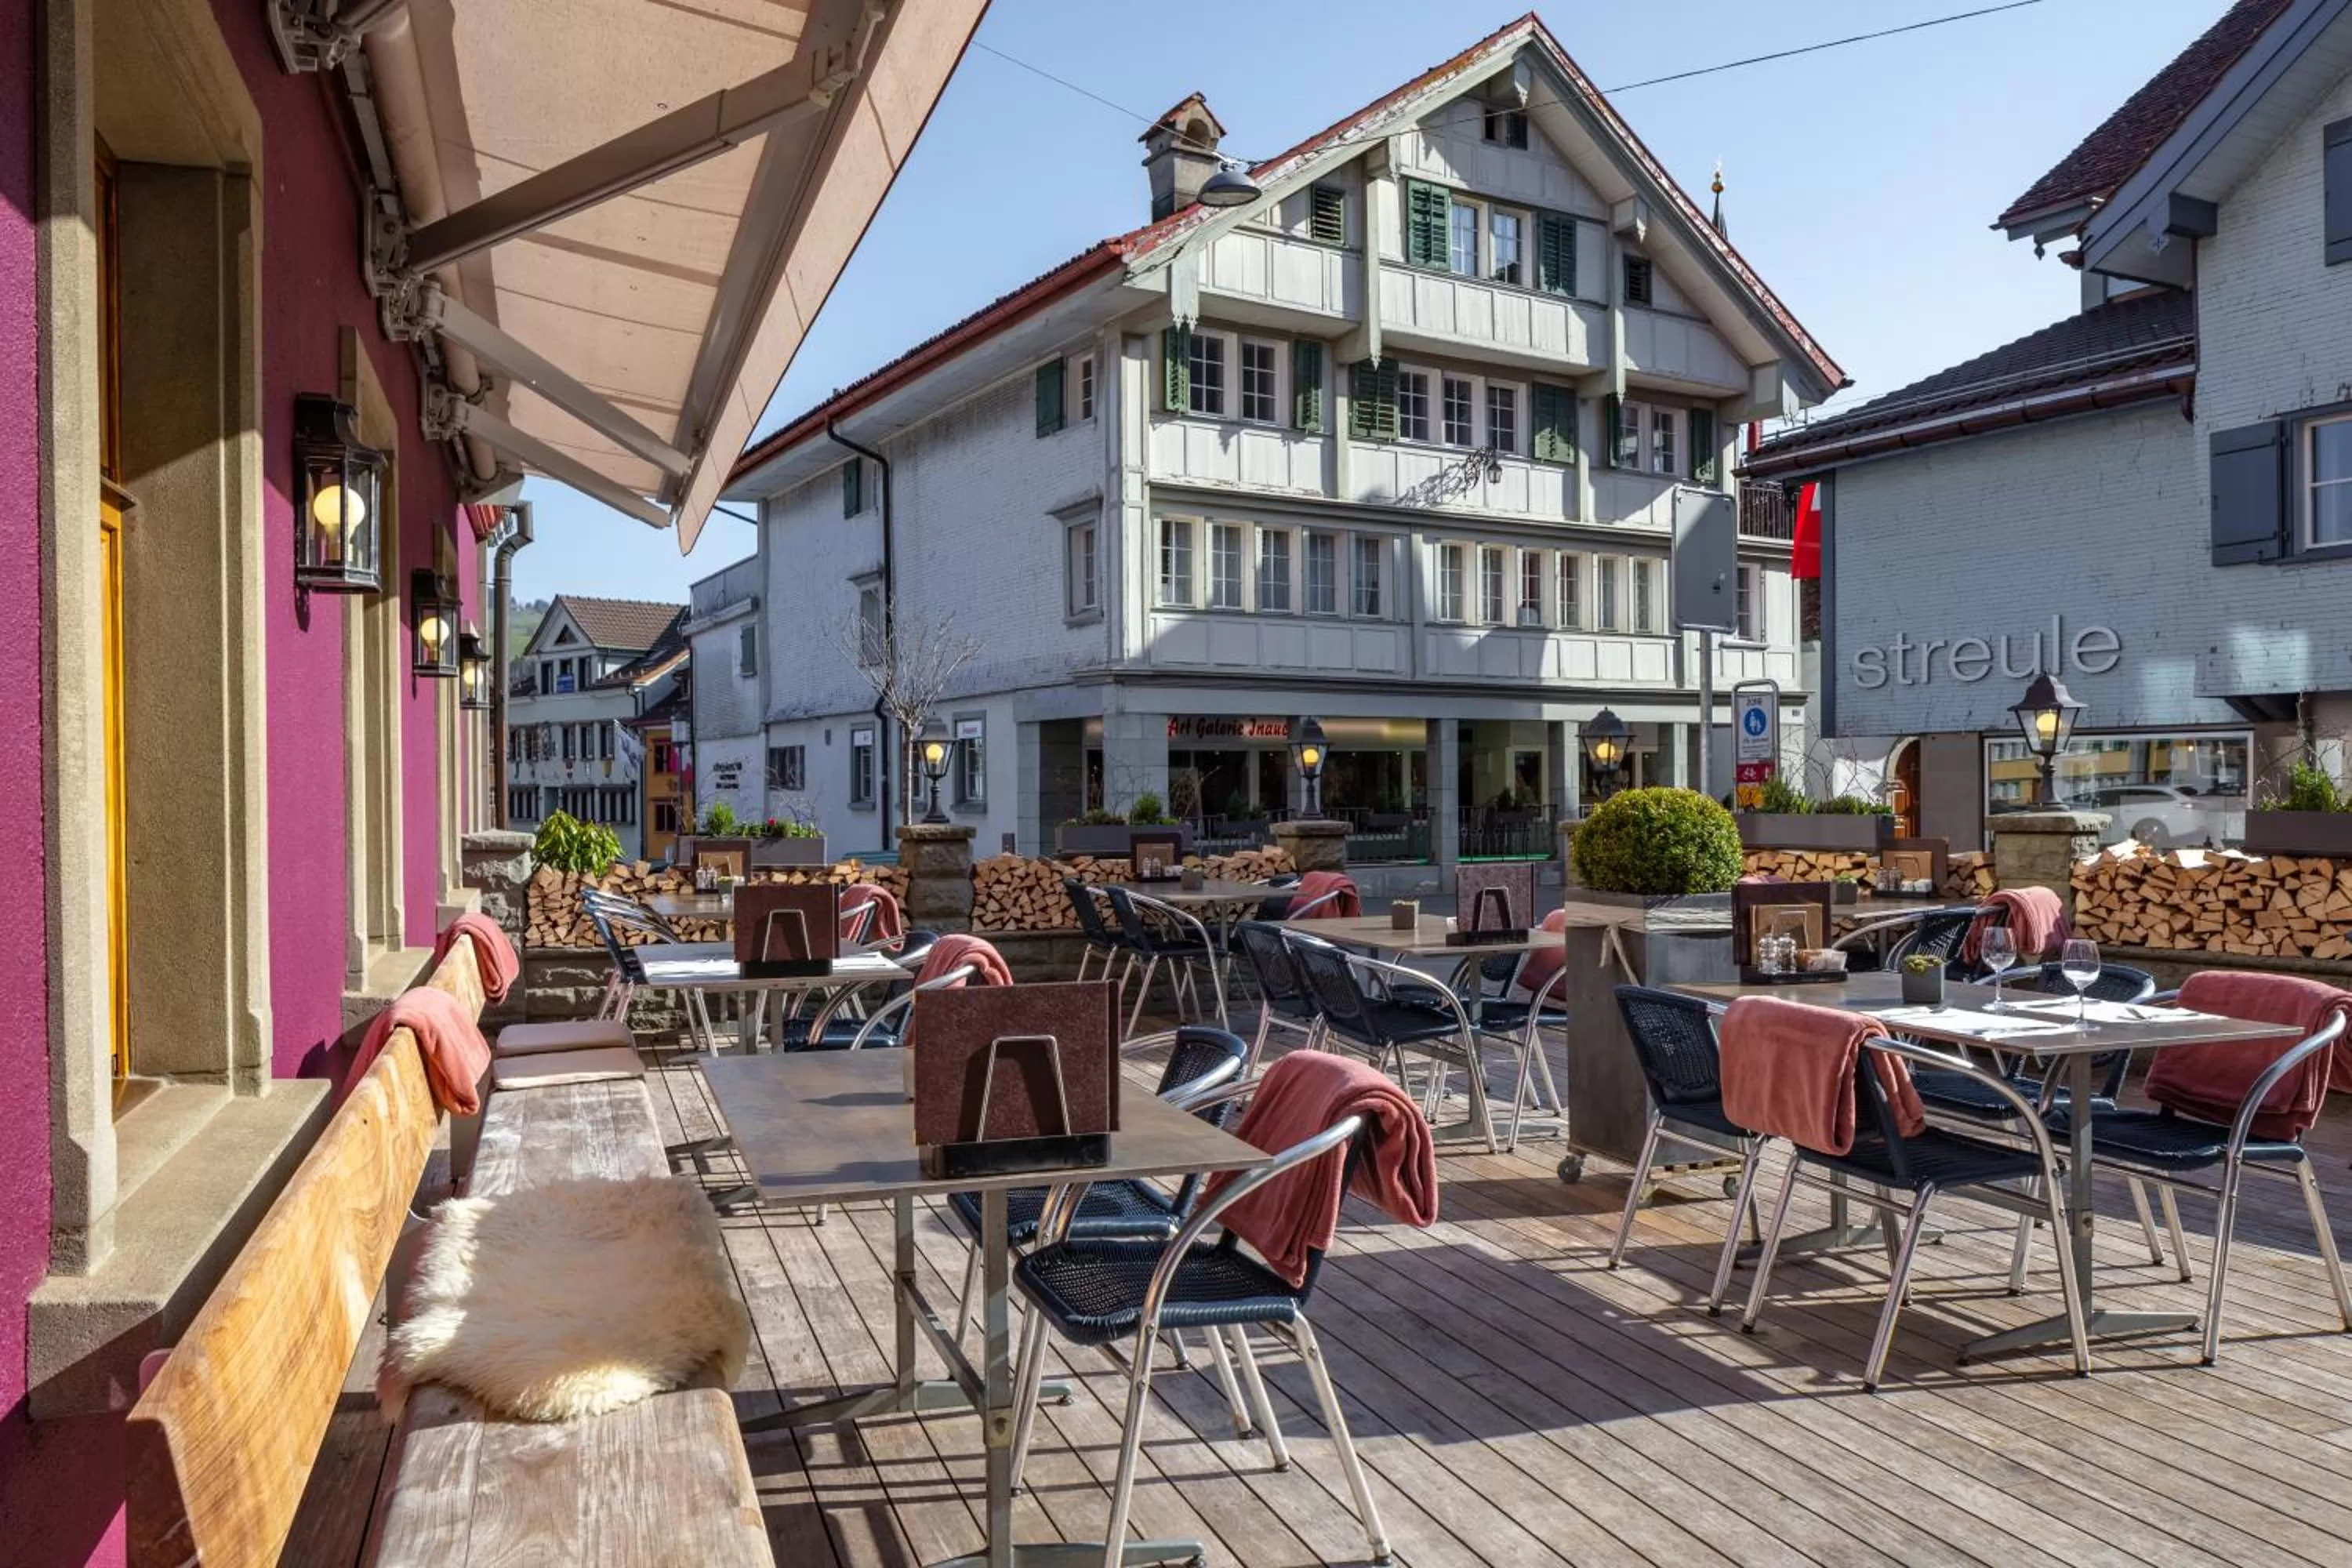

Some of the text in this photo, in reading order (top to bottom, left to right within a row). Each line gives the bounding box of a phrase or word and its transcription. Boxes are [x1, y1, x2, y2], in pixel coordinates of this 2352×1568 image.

[1853, 615, 2122, 688] streule
[1167, 715, 1190, 736] Art
[1196, 717, 1243, 739] Galerie
